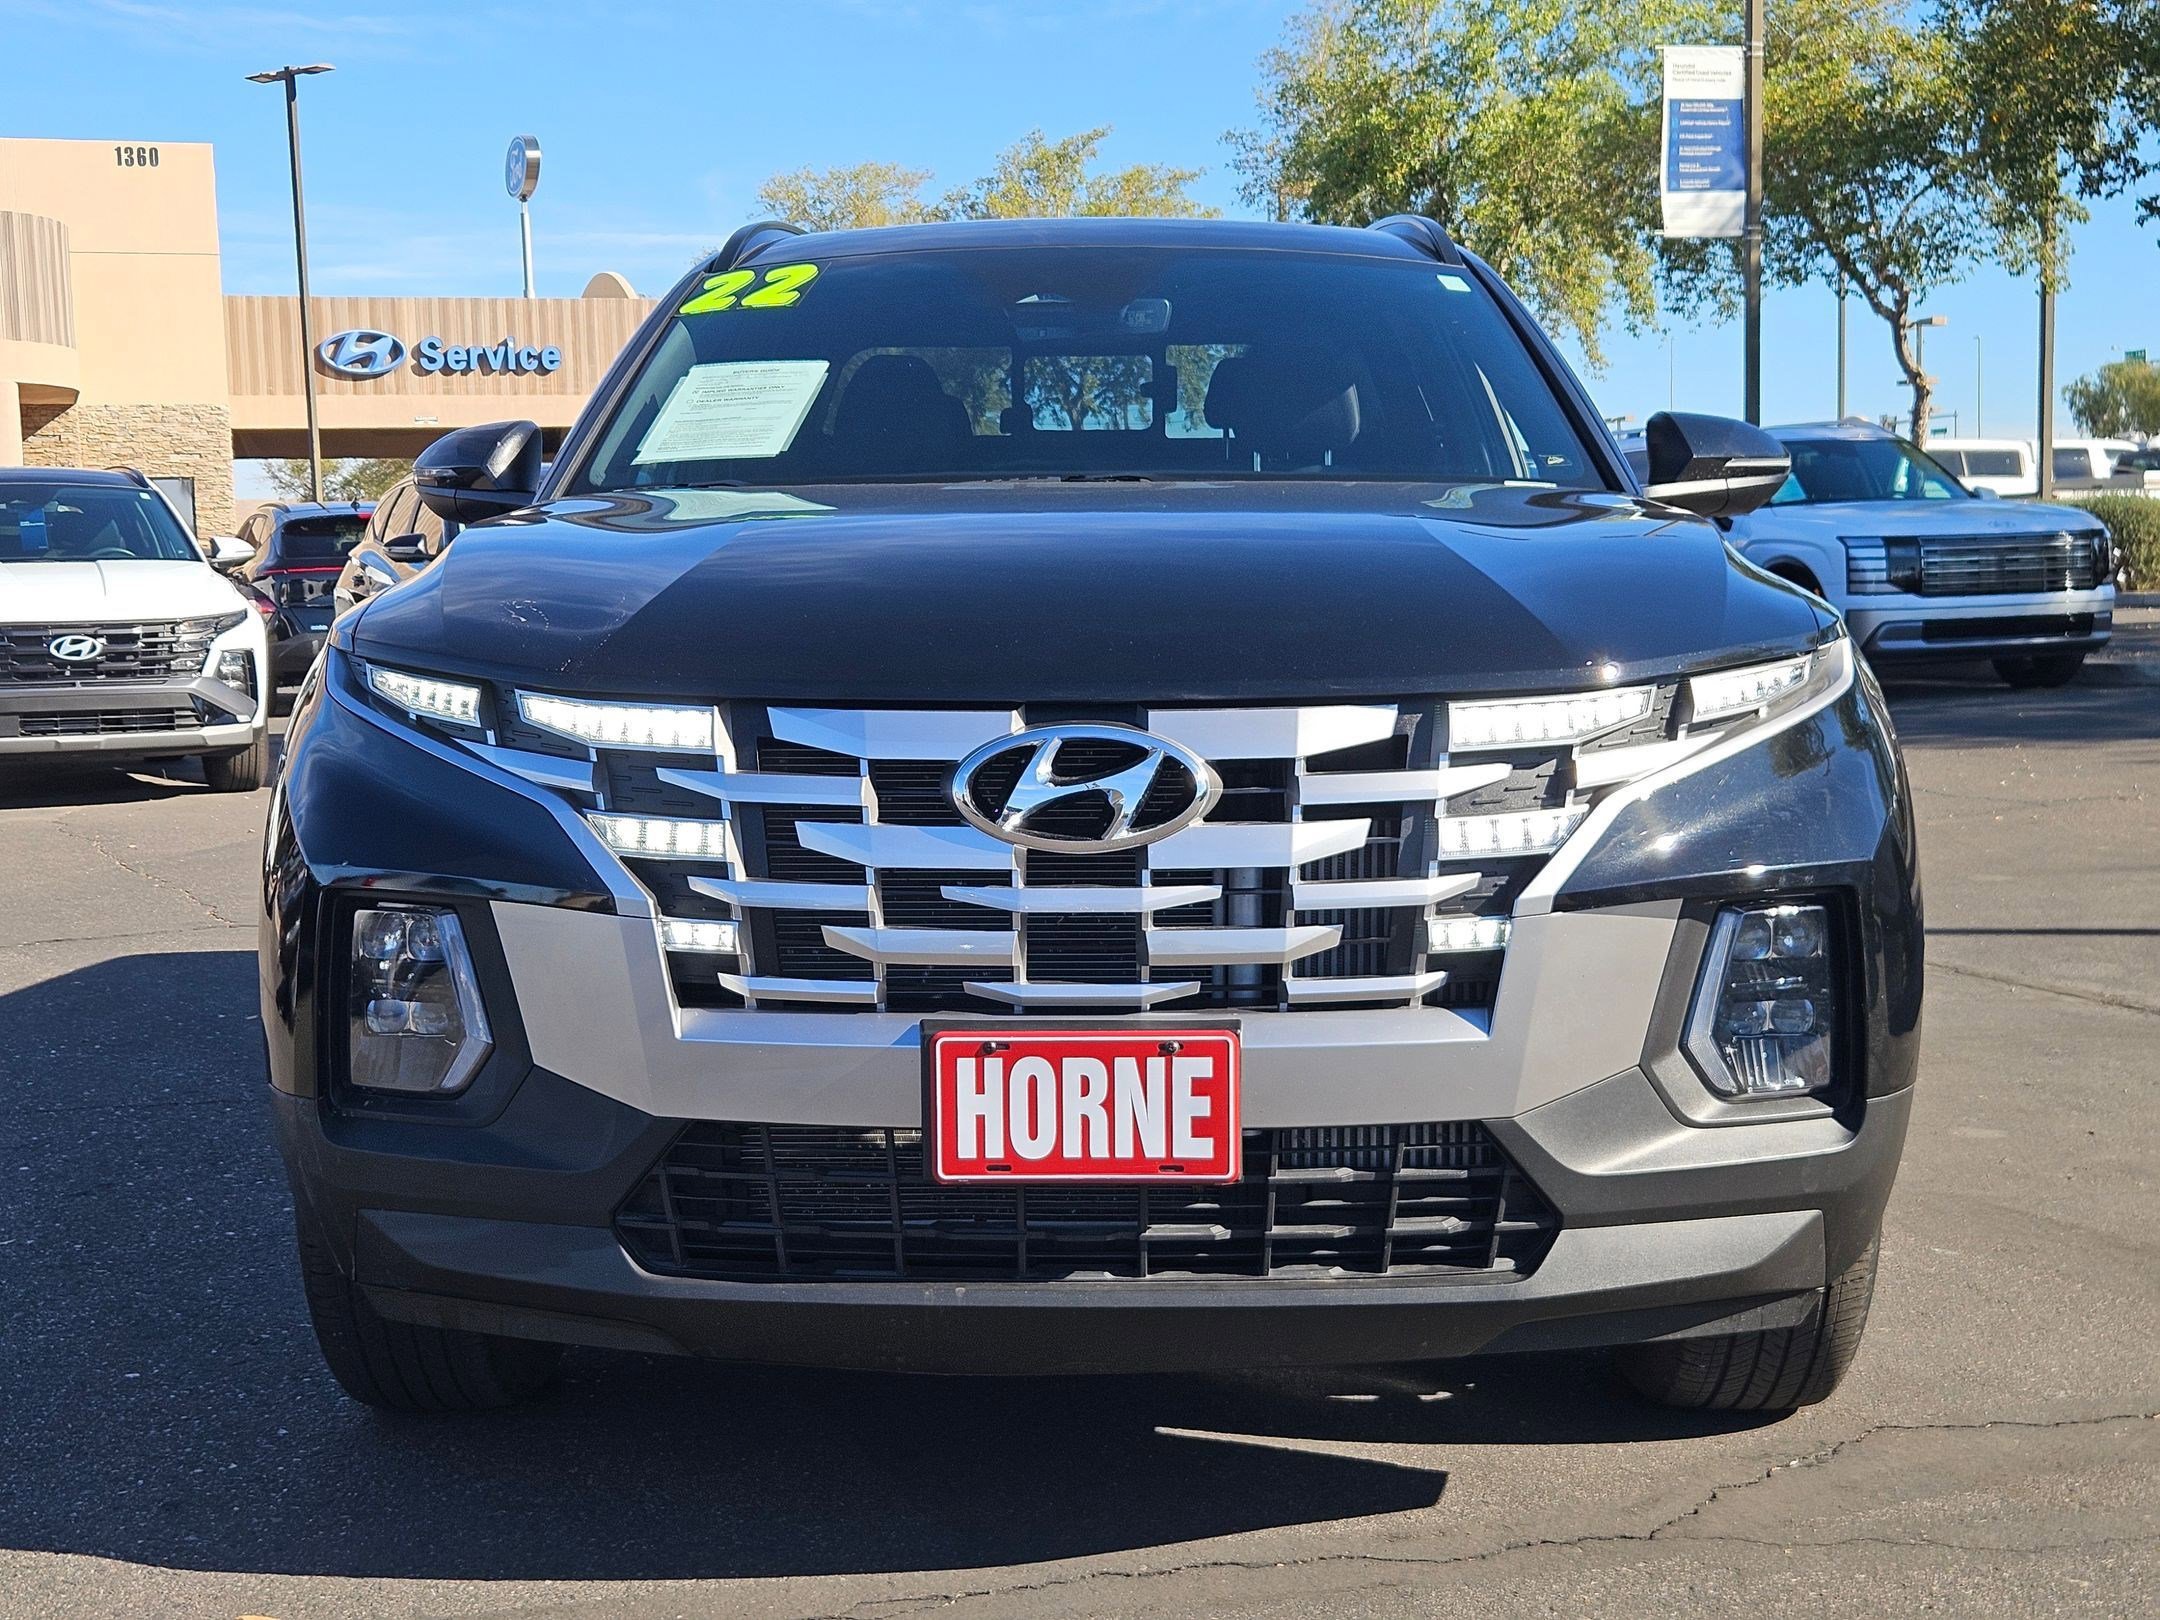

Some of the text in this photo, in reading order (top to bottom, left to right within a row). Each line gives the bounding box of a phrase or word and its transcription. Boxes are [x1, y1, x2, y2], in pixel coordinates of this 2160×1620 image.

[114, 146, 159, 167] 1360
[678, 263, 819, 315] 22
[419, 335, 562, 371] Service
[956, 1055, 1214, 1160] HORNE
